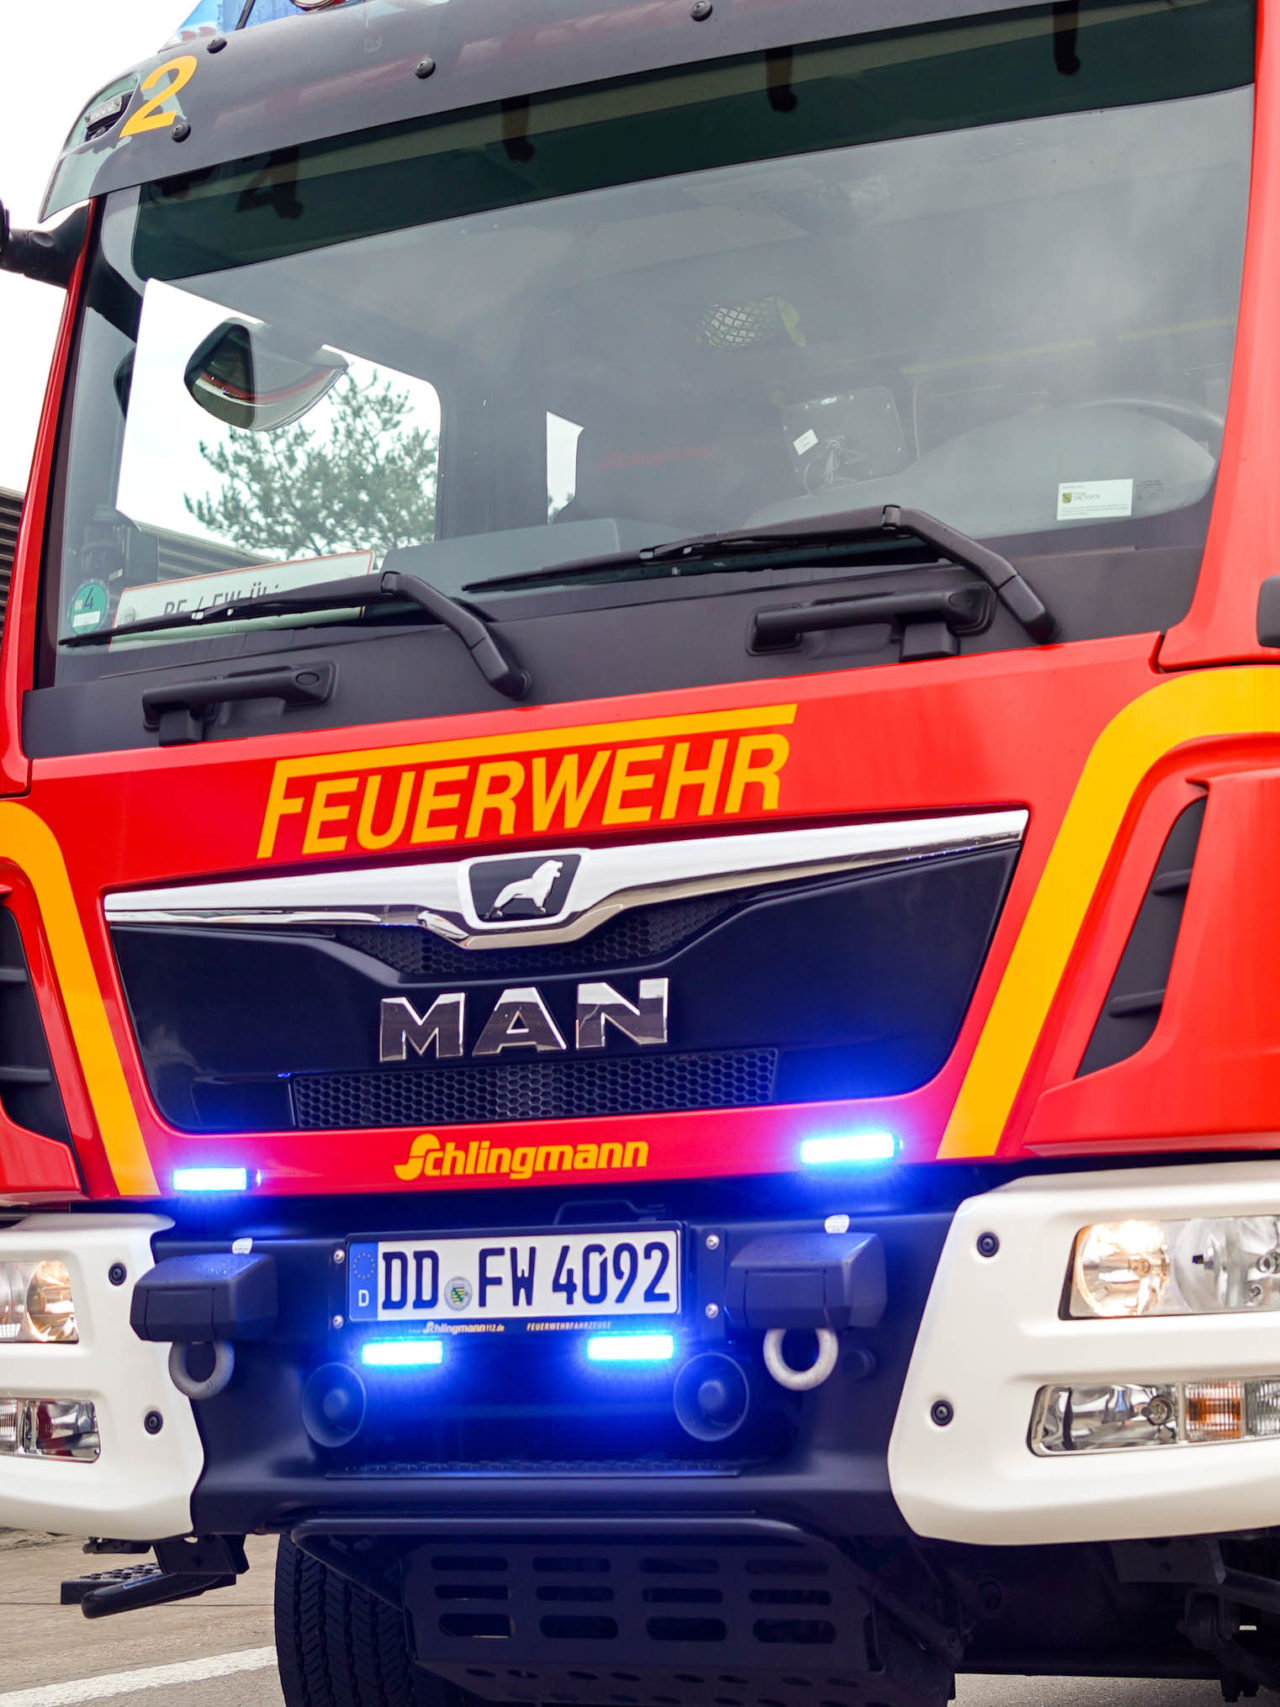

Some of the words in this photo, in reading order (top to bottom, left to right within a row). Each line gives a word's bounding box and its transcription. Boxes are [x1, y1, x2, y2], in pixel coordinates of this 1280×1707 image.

[120, 55, 197, 138] 2
[85, 587, 94, 608] 4
[257, 704, 797, 858] FEUERWEHR
[380, 977, 669, 1062] MAN
[394, 1133, 649, 1181] Schlingmann
[358, 1290, 369, 1306] D
[382, 1251, 439, 1310] DD
[478, 1247, 536, 1307] FW
[552, 1242, 670, 1304] 4092
